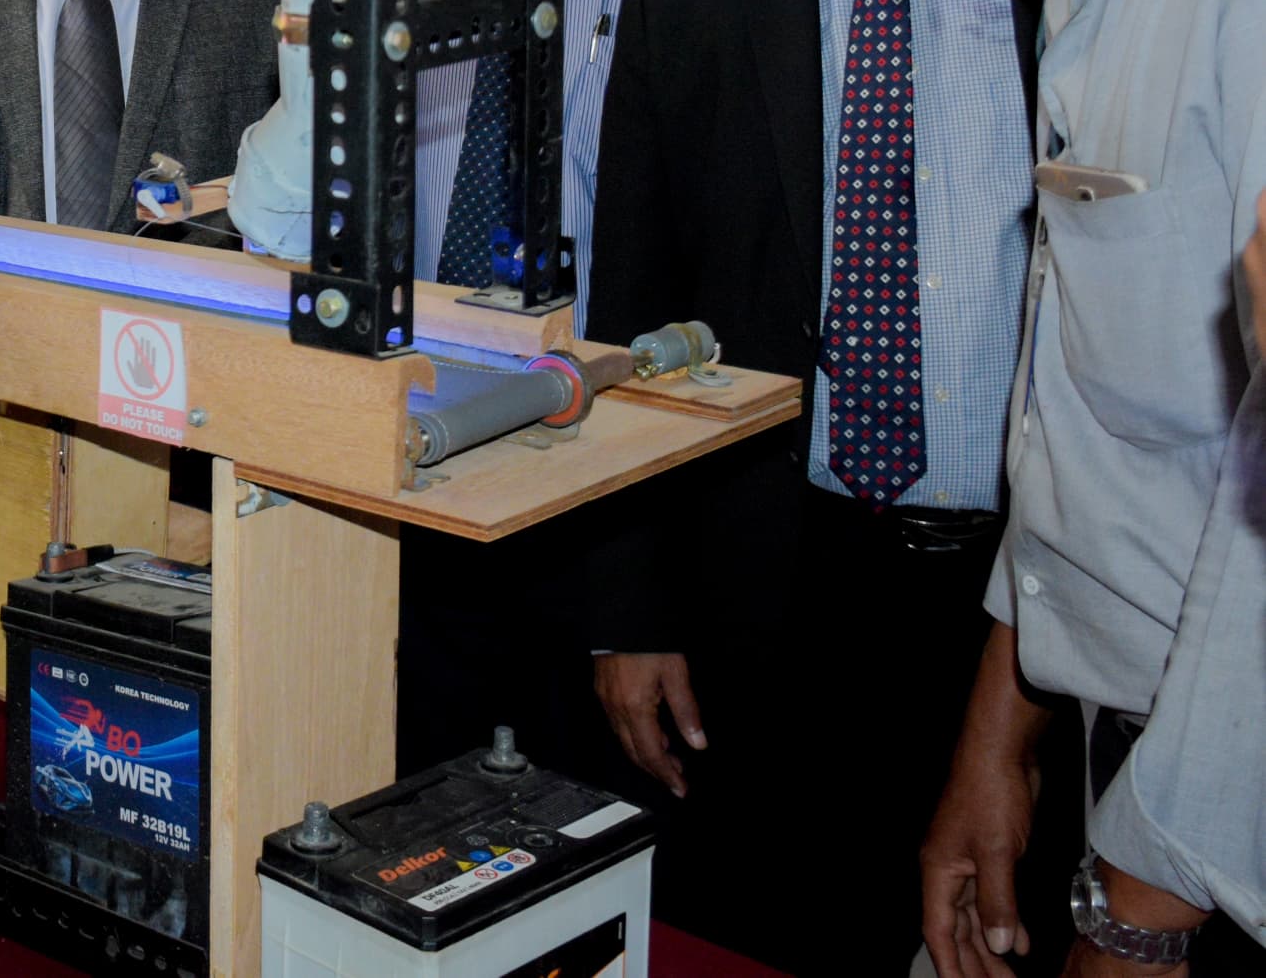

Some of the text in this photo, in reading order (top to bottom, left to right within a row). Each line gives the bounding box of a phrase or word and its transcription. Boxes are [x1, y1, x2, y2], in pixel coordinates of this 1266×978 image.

[102, 412, 183, 441] DO NOT TOUCH
[123, 403, 165, 422] PLEASE
[114, 684, 190, 711] KOREA TECHNOLOGY
[85, 749, 173, 801] POWER
[119, 806, 191, 842] MF 32B19L
[154, 833, 169, 845] 12V
[377, 846, 448, 883] Delkor
